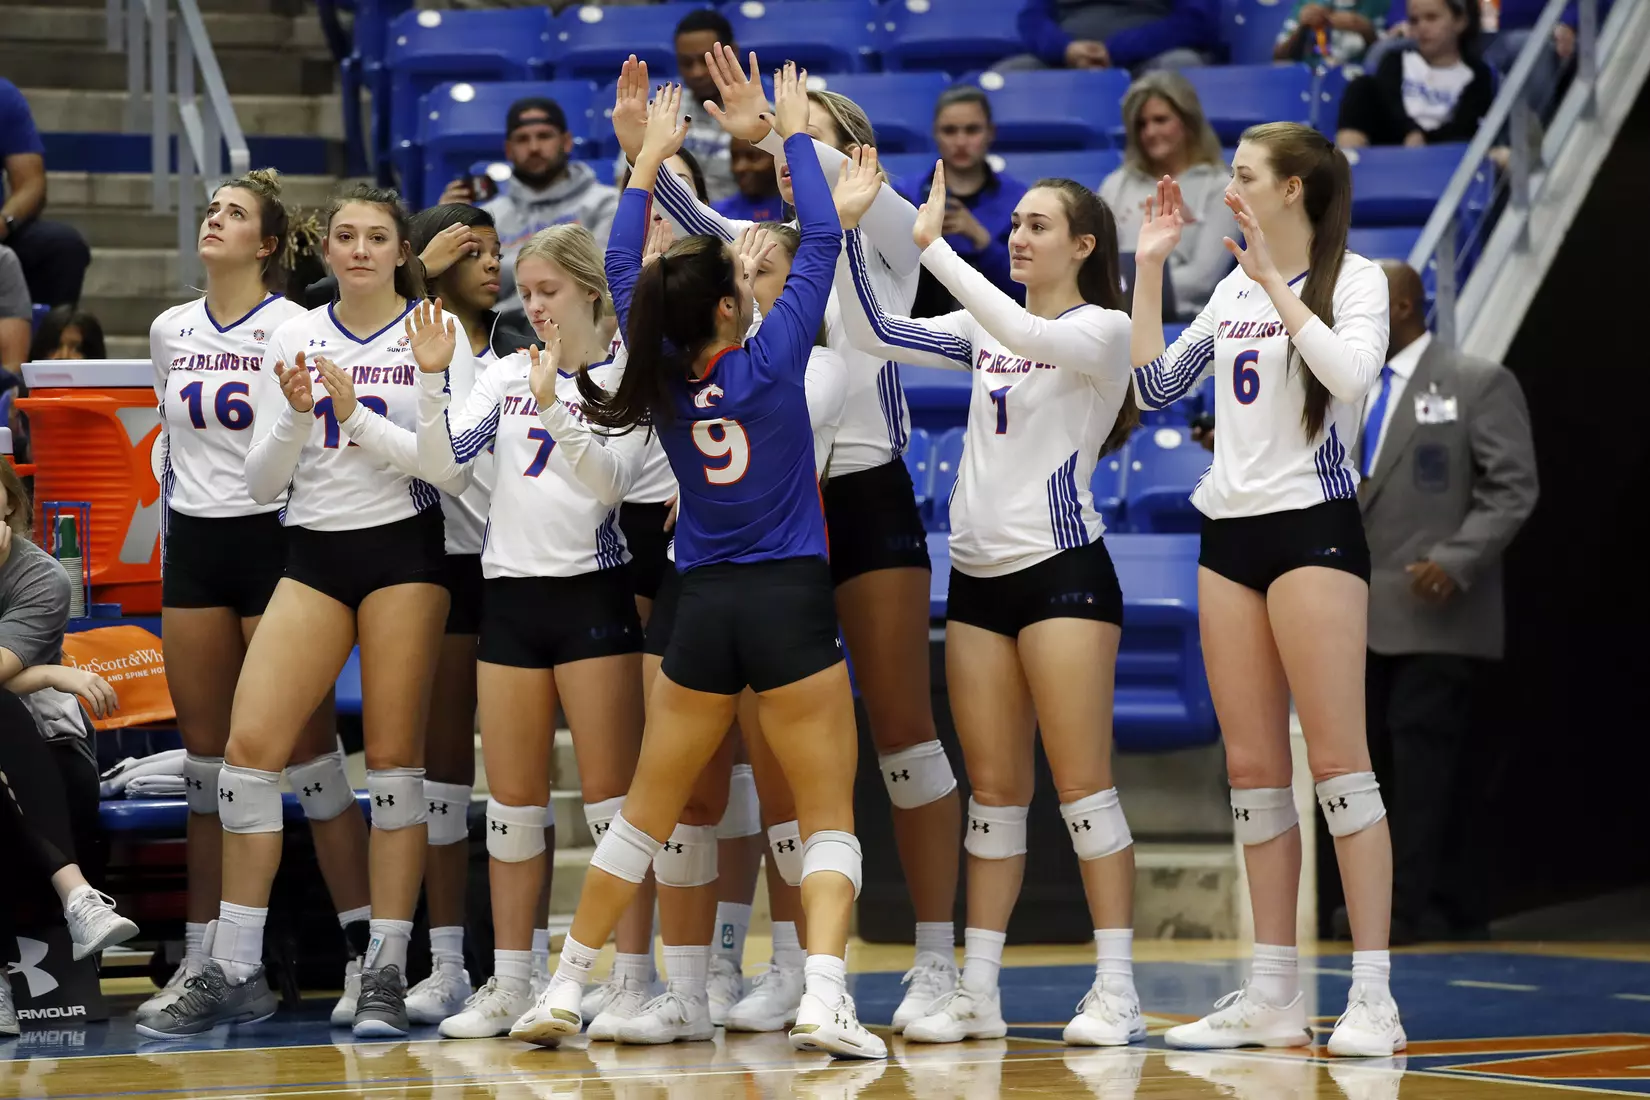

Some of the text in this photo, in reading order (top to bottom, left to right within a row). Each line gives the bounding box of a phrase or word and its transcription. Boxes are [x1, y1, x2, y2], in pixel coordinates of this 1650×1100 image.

[1232, 349, 1260, 405] 6
[179, 380, 254, 431] 16
[503, 395, 523, 416] UT
[523, 427, 557, 478] 7
[690, 416, 751, 486] 9
[107, 673, 124, 682] AND
[125, 670, 149, 680] SPINE
[16, 1005, 87, 1020] RMOUR
